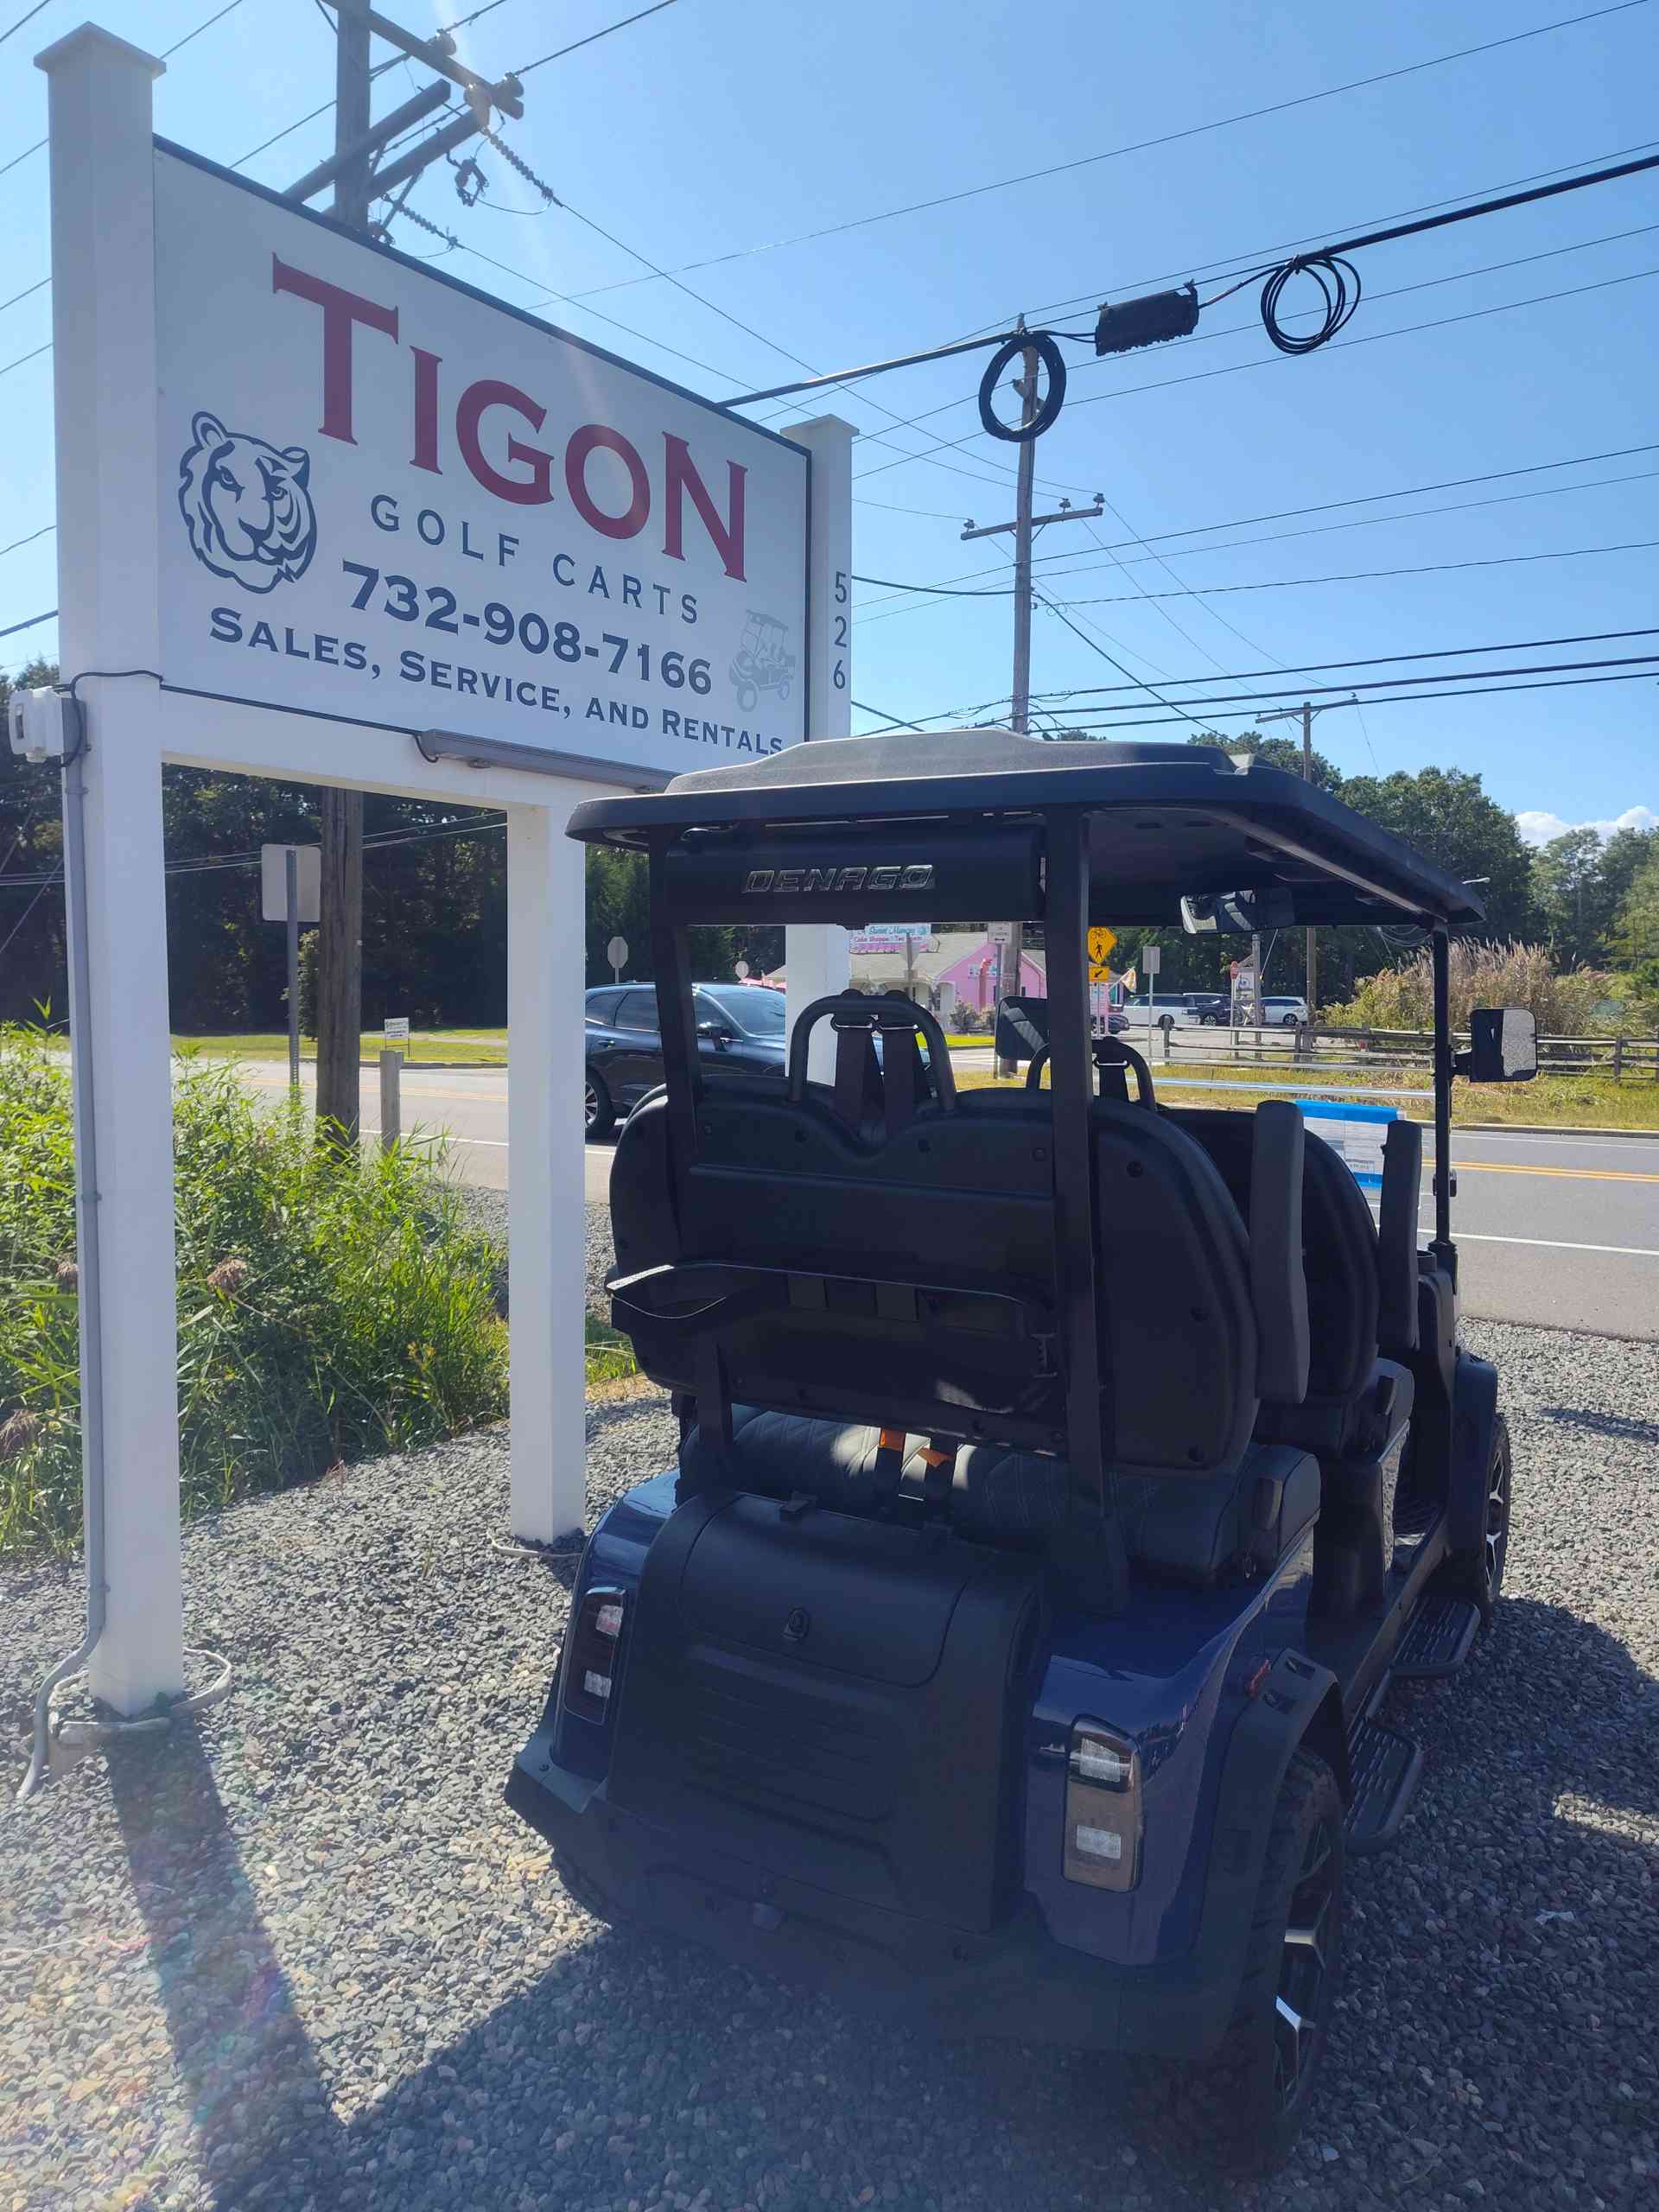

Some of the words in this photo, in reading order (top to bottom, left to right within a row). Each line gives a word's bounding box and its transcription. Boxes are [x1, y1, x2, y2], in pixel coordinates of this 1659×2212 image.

[272, 251, 748, 583] TIGON
[340, 557, 713, 696] 732-908-7166
[370, 493, 520, 568] GOLF
[552, 552, 699, 625] CARTS
[209, 606, 382, 679] SALES,
[398, 649, 572, 720] SERVICE,
[585, 696, 651, 730] AND
[661, 708, 783, 755] RENTALS
[743, 863, 934, 893] DENAGO
